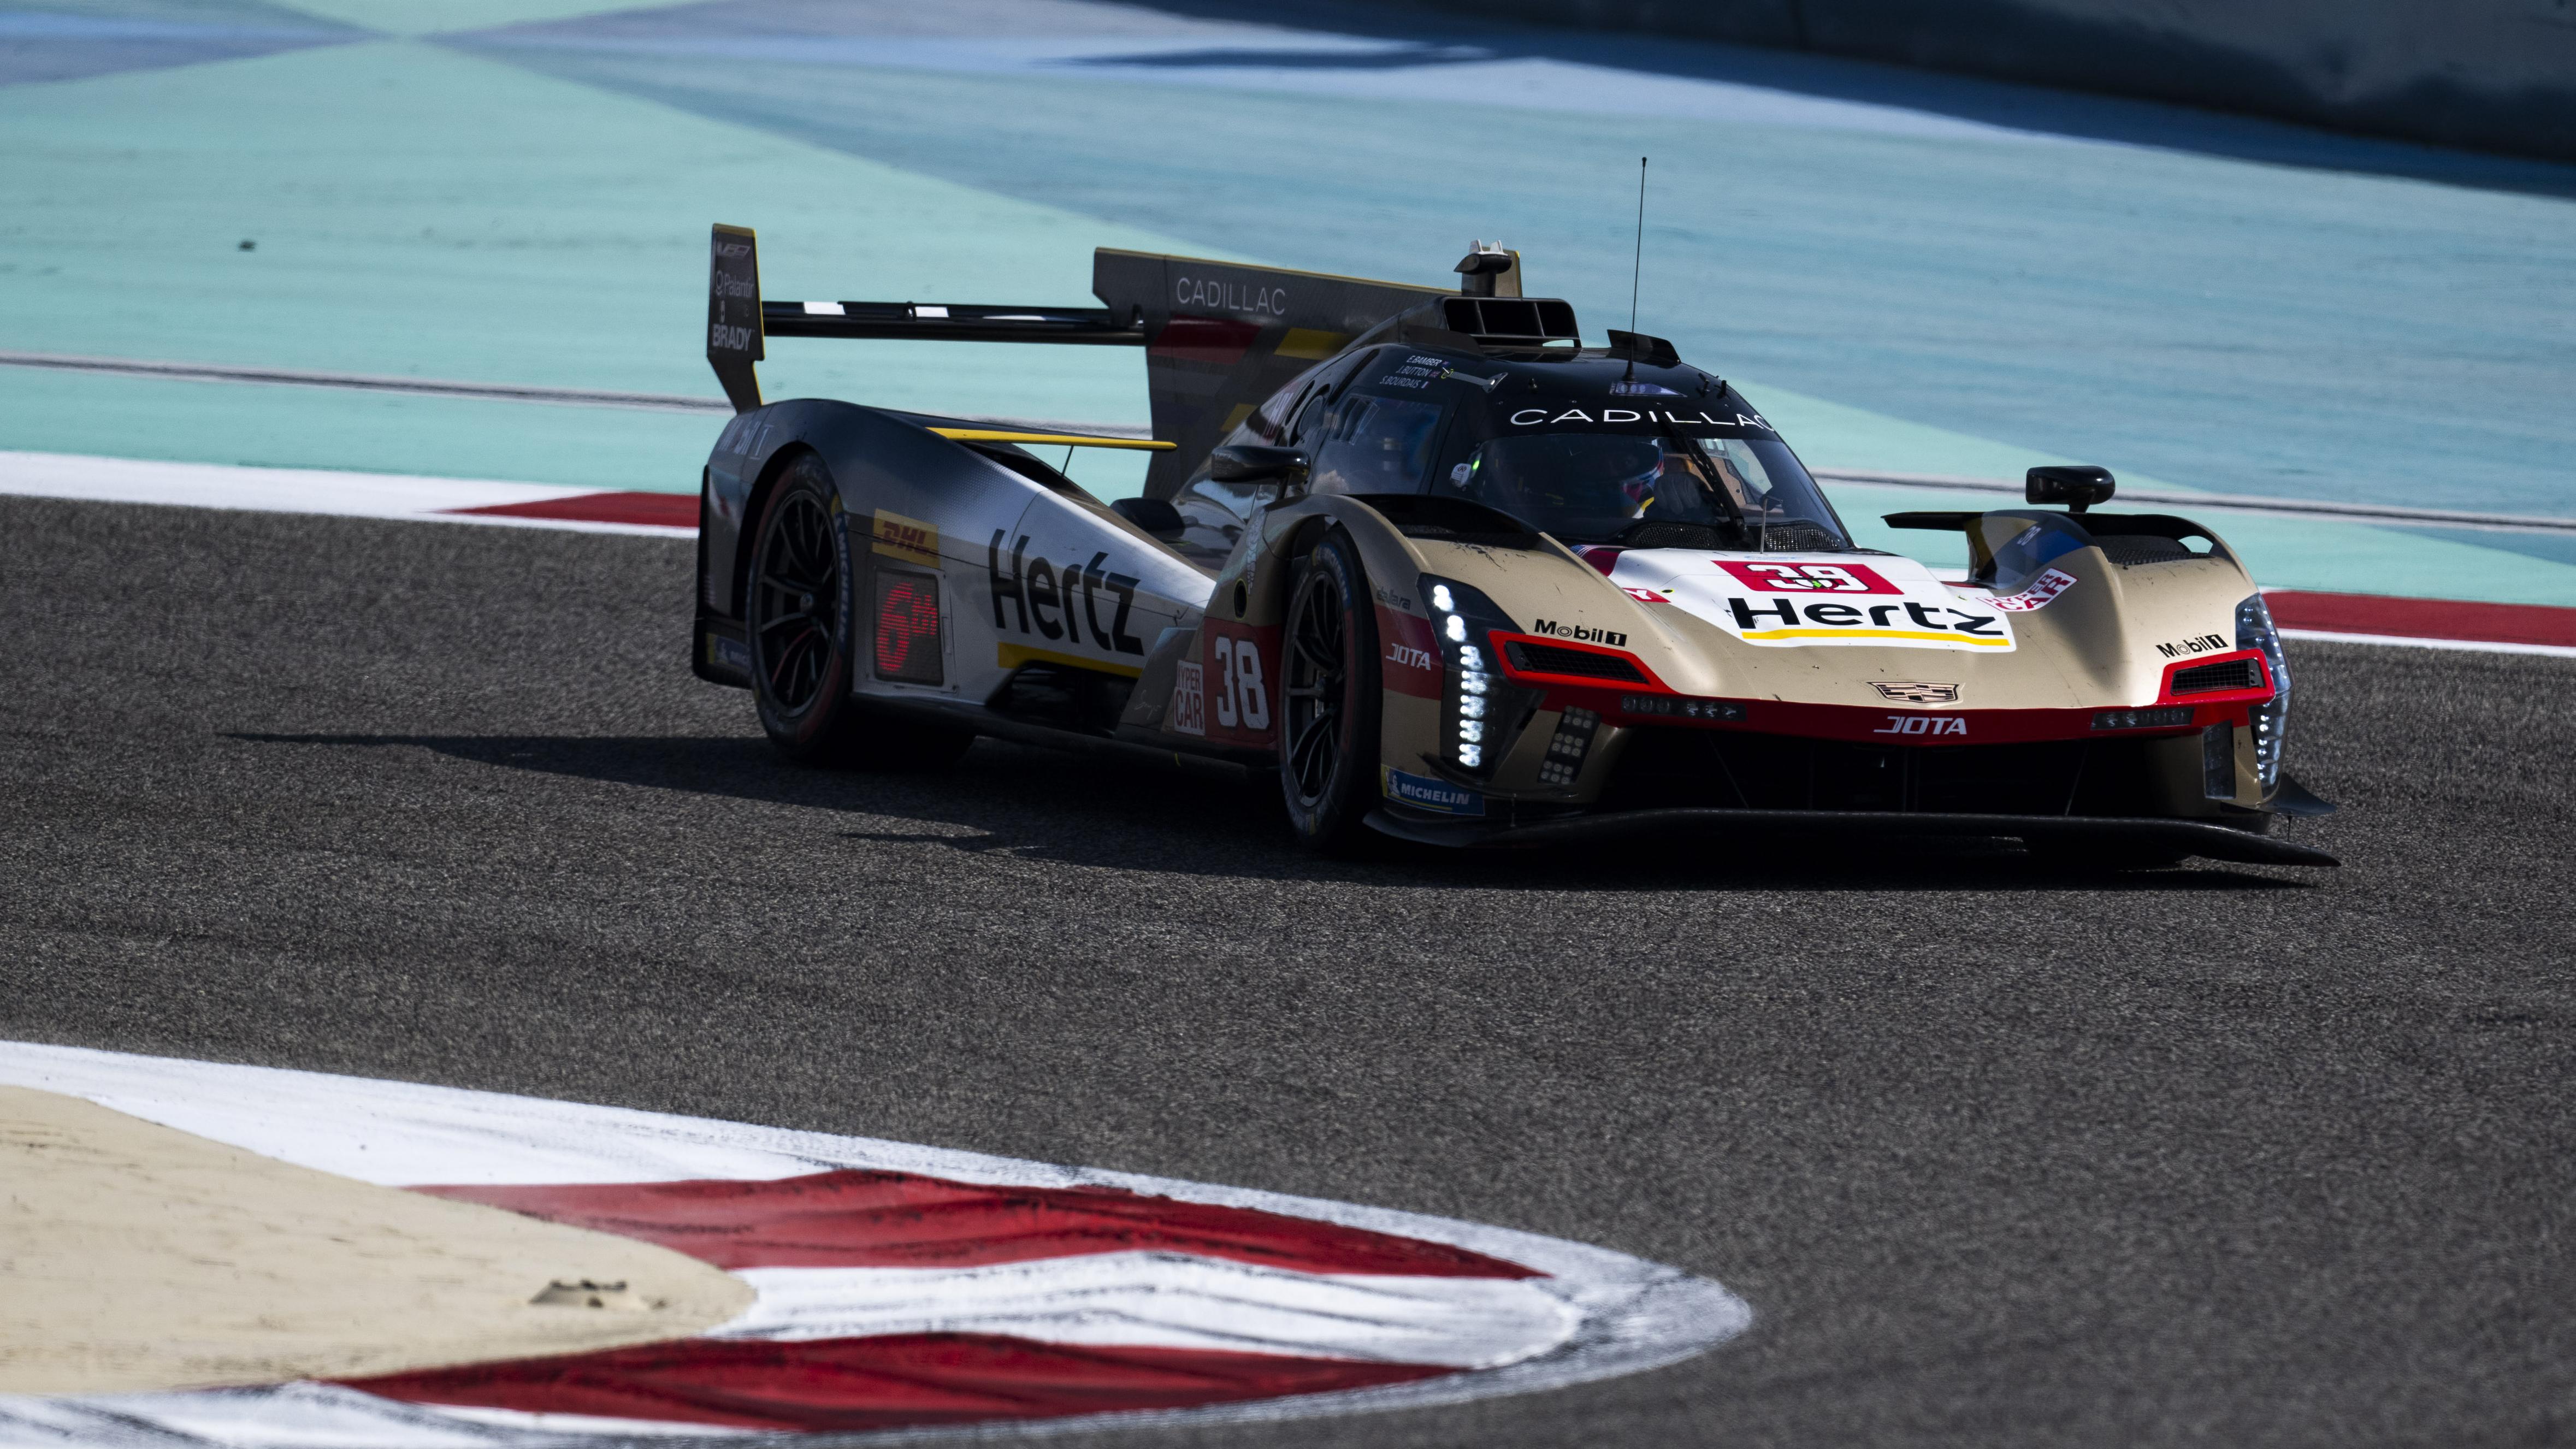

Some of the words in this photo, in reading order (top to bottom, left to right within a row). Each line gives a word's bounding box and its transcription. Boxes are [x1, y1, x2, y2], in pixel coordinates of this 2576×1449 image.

[724, 274, 754, 298] Palantir
[1177, 277, 1286, 316] CADILLAC
[712, 323, 752, 351] BRADY
[1510, 409, 1774, 432] CADILLAC
[883, 521, 930, 555] DHL
[989, 529, 1144, 656] Hertz
[1995, 577, 2070, 611] CAR
[1534, 619, 1603, 643] Mobil
[1728, 598, 2004, 636] Hertz
[1386, 643, 1432, 671] JOTA
[2155, 636, 2213, 658] Mobil
[1215, 636, 1271, 730] 38
[1175, 689, 1203, 730] CAR
[1873, 716, 1968, 735] JOTA
[1401, 783, 1470, 805] MICHELIN
